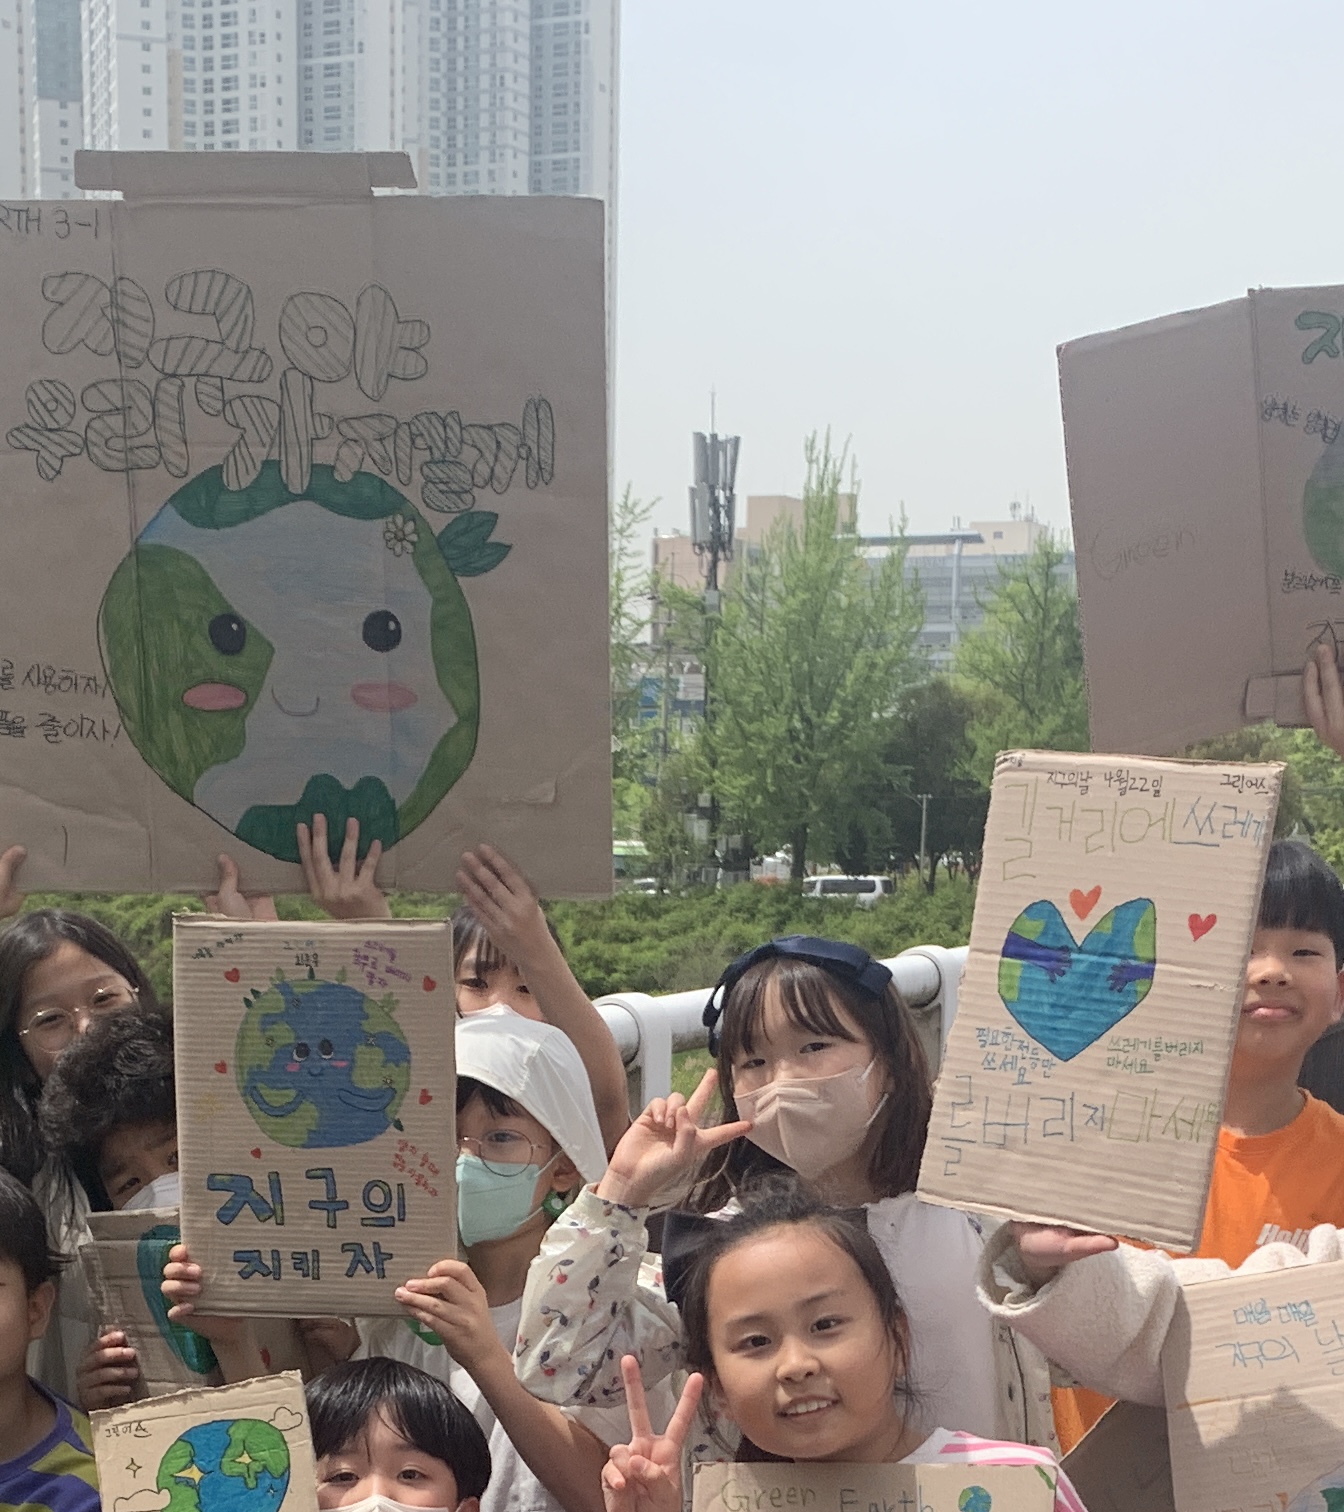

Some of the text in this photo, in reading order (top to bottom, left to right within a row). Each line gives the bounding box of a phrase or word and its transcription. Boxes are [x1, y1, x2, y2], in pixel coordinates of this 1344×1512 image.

[55, 207, 99, 239] 3-1
[41, 268, 431, 410] 지구야
[1219, 773, 1269, 796] 그린어스
[207, 1167, 406, 1229] 지구의
[105, 1421, 153, 1438] 그린어스
[721, 1478, 817, 1512] Green
